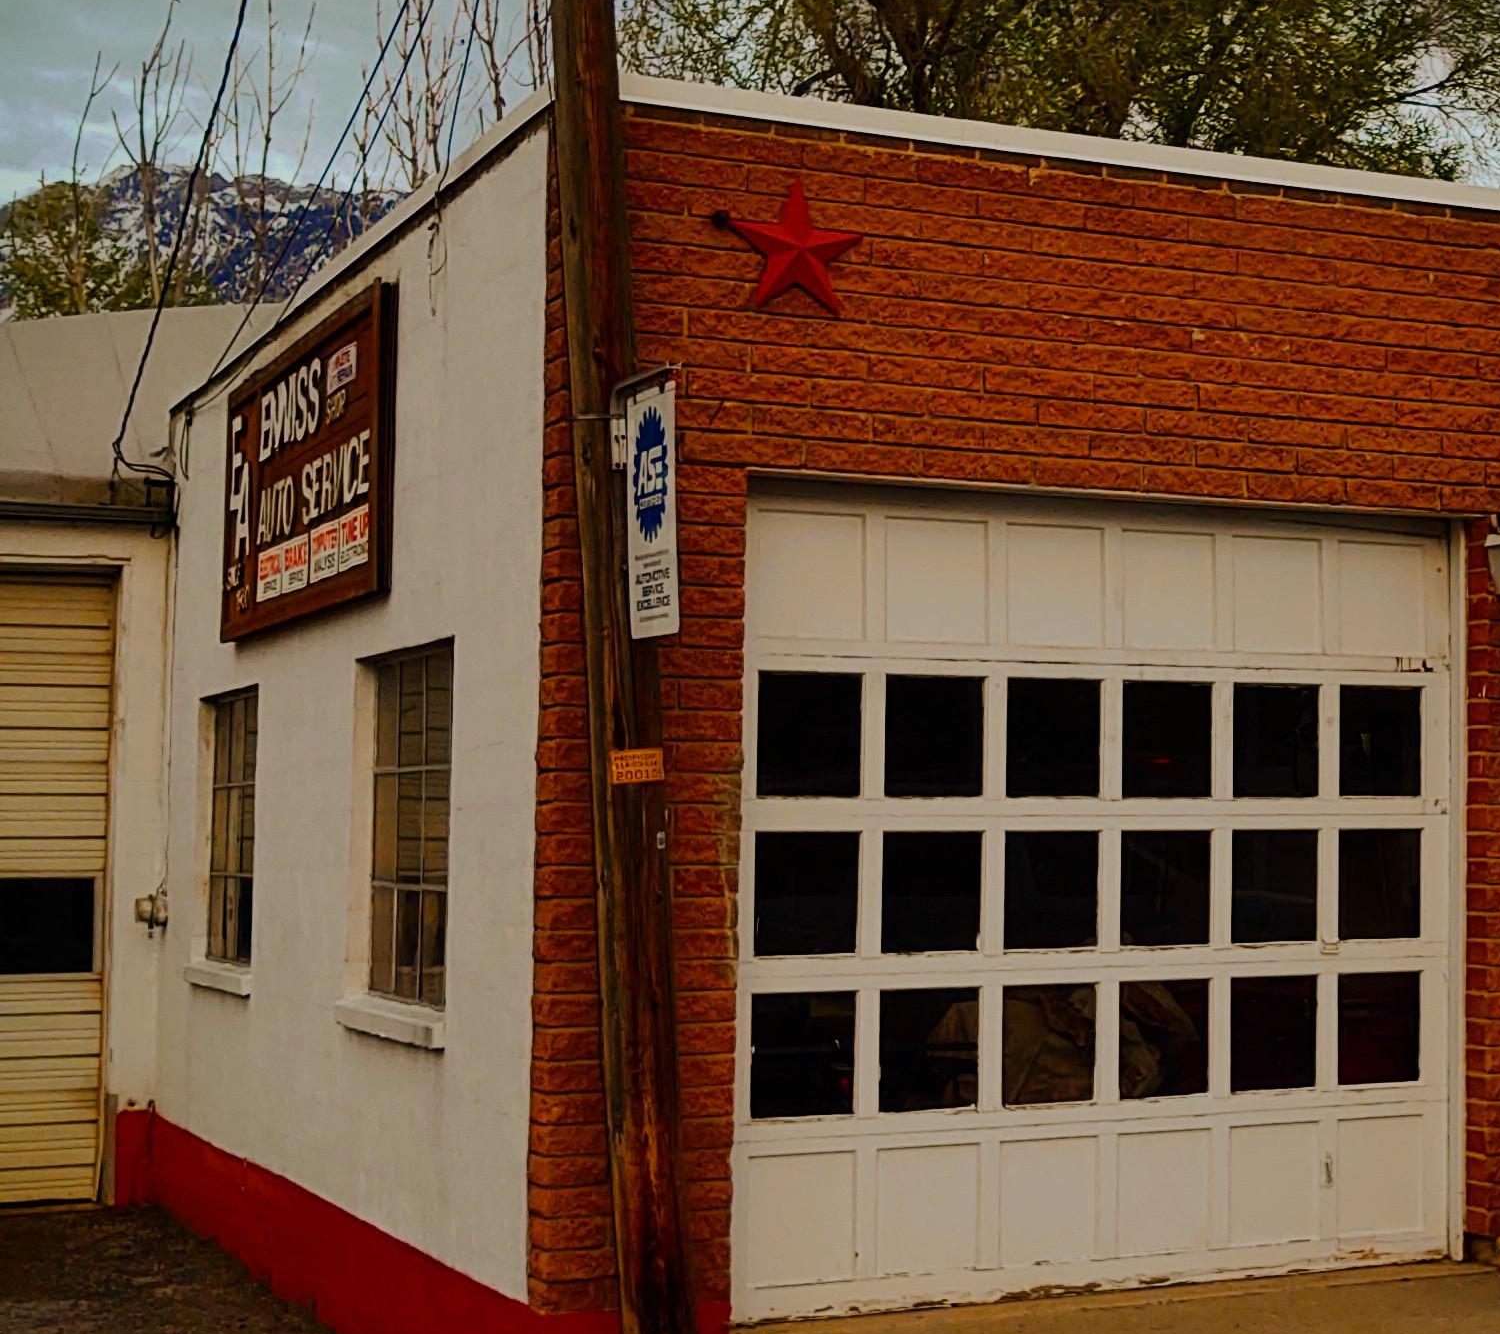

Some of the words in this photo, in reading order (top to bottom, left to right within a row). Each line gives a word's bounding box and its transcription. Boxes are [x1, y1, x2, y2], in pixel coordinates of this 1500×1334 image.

[259, 357, 322, 463] ENNISS
[256, 475, 295, 547] AUTO
[301, 428, 370, 526] SERVICE
[636, 444, 664, 497] ASE
[284, 541, 308, 572] BRAKE
